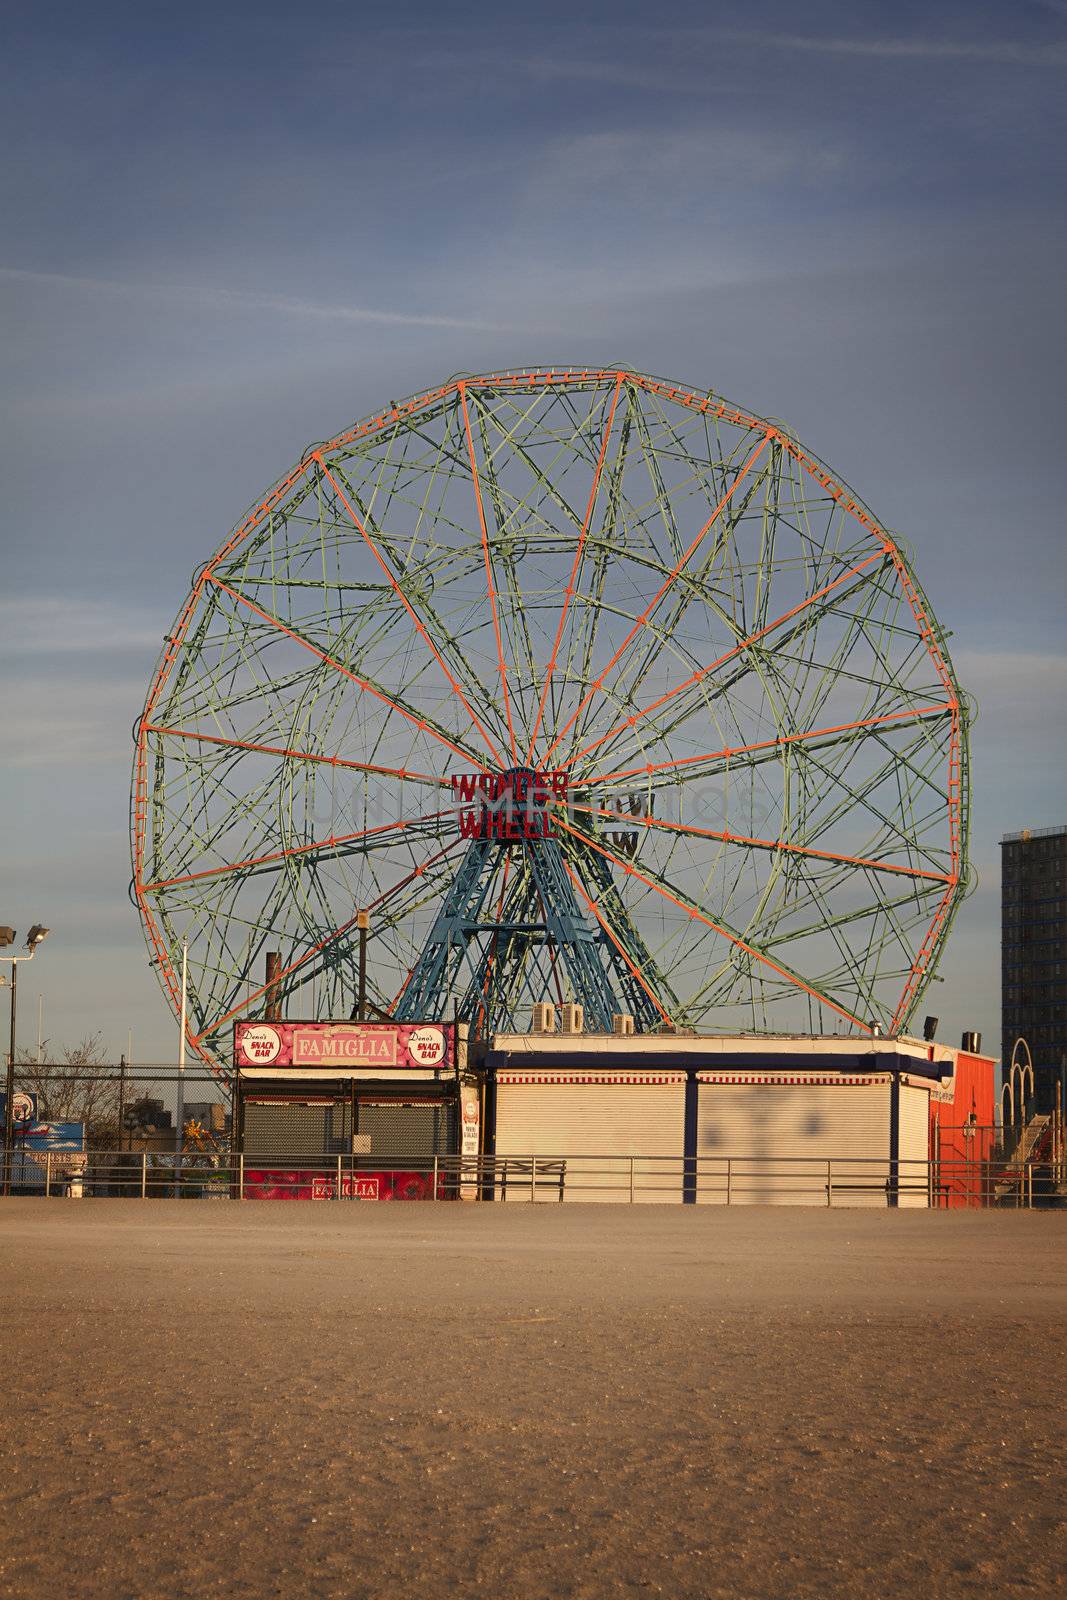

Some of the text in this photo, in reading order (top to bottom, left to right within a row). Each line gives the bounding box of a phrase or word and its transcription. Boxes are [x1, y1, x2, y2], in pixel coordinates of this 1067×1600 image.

[452, 773, 568, 802] WONDER
[460, 810, 559, 838] WHEEL
[251, 1041, 274, 1049] SNACK
[298, 1039, 391, 1057] FAMIGLIA
[417, 1043, 440, 1051] SNACK
[254, 1049, 271, 1057] BAR
[421, 1051, 437, 1059] BAR
